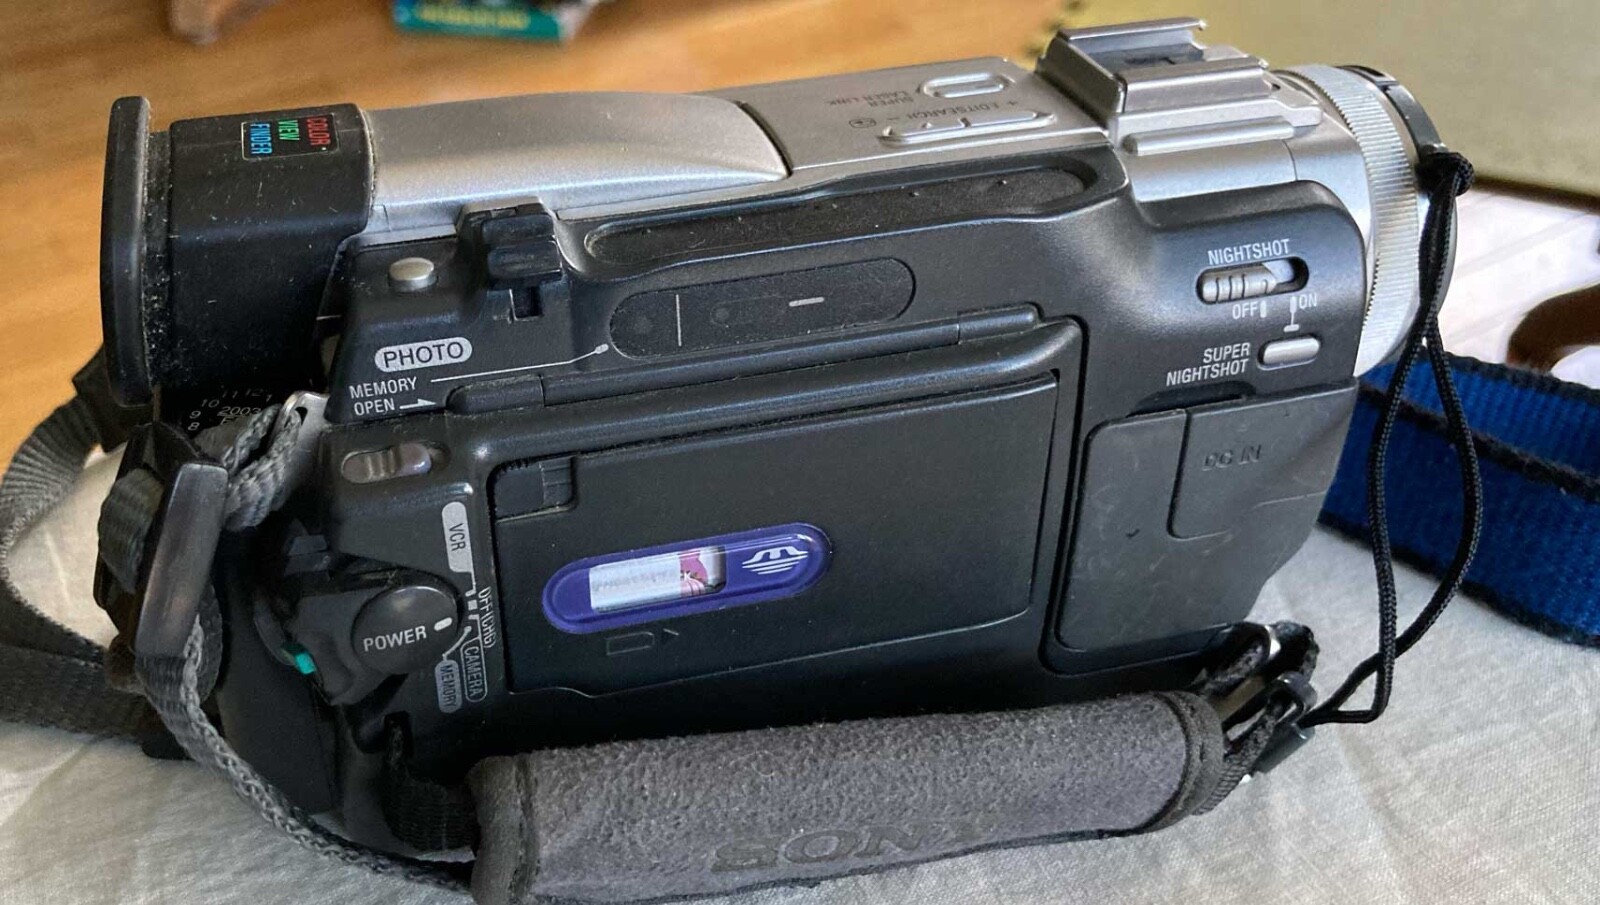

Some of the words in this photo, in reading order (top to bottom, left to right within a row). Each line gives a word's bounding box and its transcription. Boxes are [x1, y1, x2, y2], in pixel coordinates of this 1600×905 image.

[907, 102, 1000, 120] EDITSEARCH
[250, 124, 272, 154] FINDER
[278, 120, 300, 141] VIEW
[307, 118, 331, 146] COLOR
[1207, 238, 1290, 265] NIGHTSHOT
[1232, 302, 1258, 319] OFF
[1299, 294, 1317, 309] ON
[383, 341, 464, 369] PHOTO
[1203, 342, 1251, 364] SUPER
[1166, 358, 1249, 387] NIGHTSHOT
[349, 376, 417, 400] MEMORY
[354, 398, 395, 416] OPEN
[449, 522, 466, 551] VCR
[478, 585, 497, 649] OFF(CHG)
[363, 625, 427, 652] POWER
[464, 646, 483, 697] CAMERA
[440, 664, 458, 708] MEMORY
